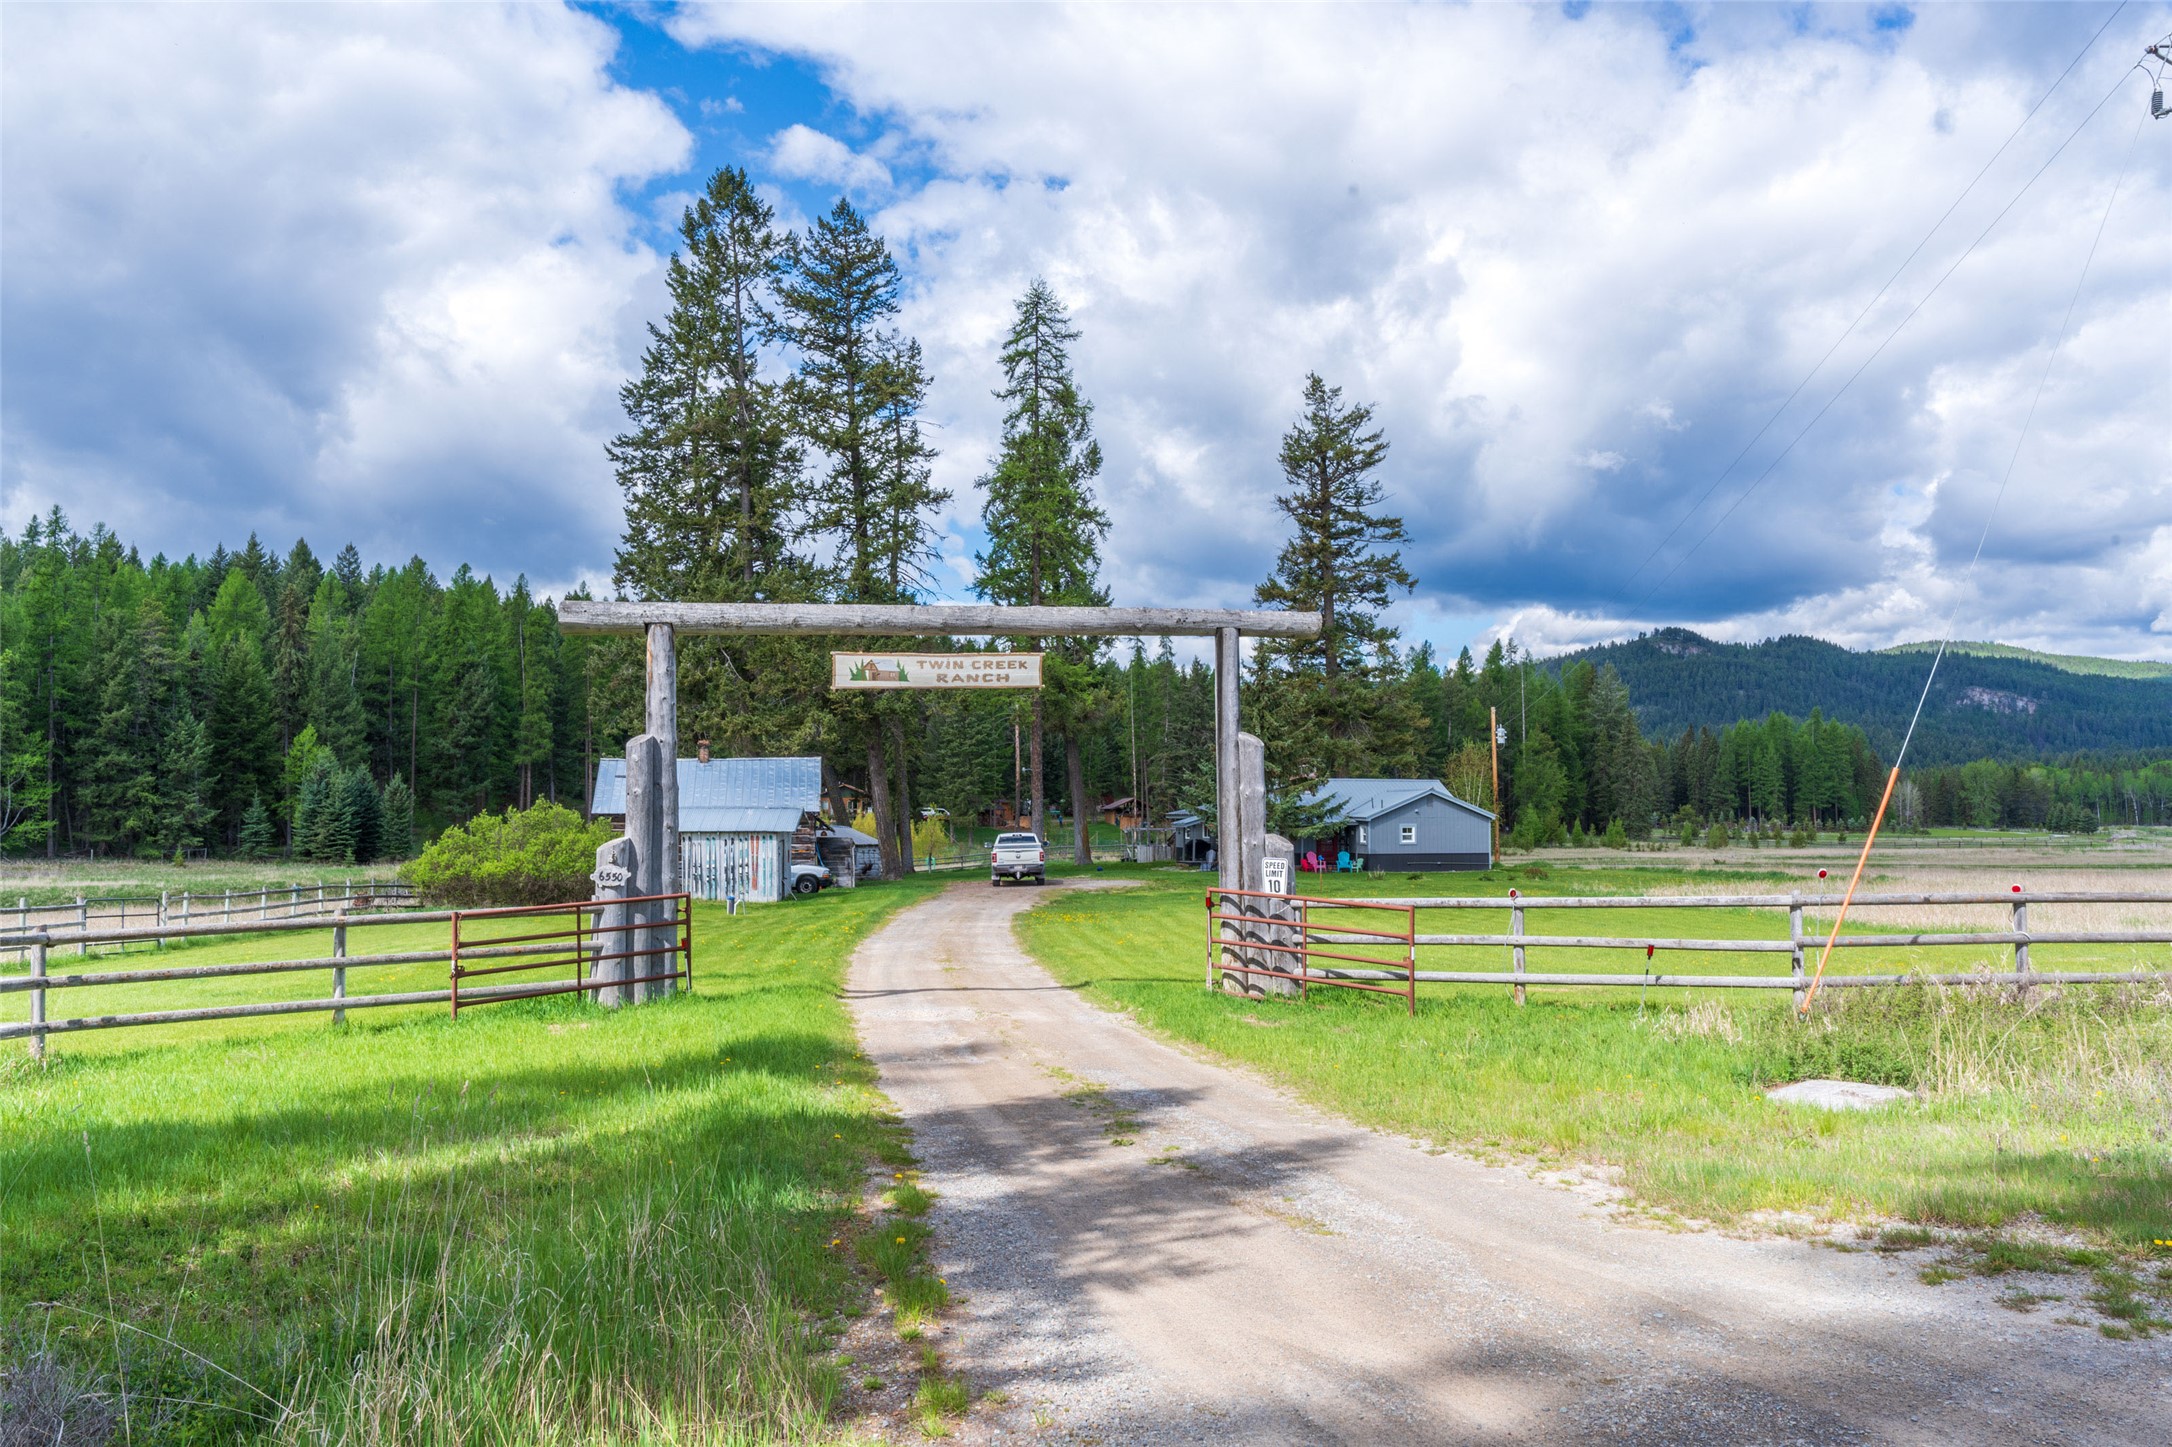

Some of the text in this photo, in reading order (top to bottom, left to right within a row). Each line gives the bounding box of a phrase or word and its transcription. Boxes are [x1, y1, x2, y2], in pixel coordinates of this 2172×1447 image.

[971, 660, 1028, 670] CREEK
[936, 674, 1010, 683] RANCH
[1265, 862, 1285, 870] SPEED
[599, 871, 623, 882] 6550
[1265, 870, 1283, 878] LIMIT
[1268, 879, 1281, 893] 10
